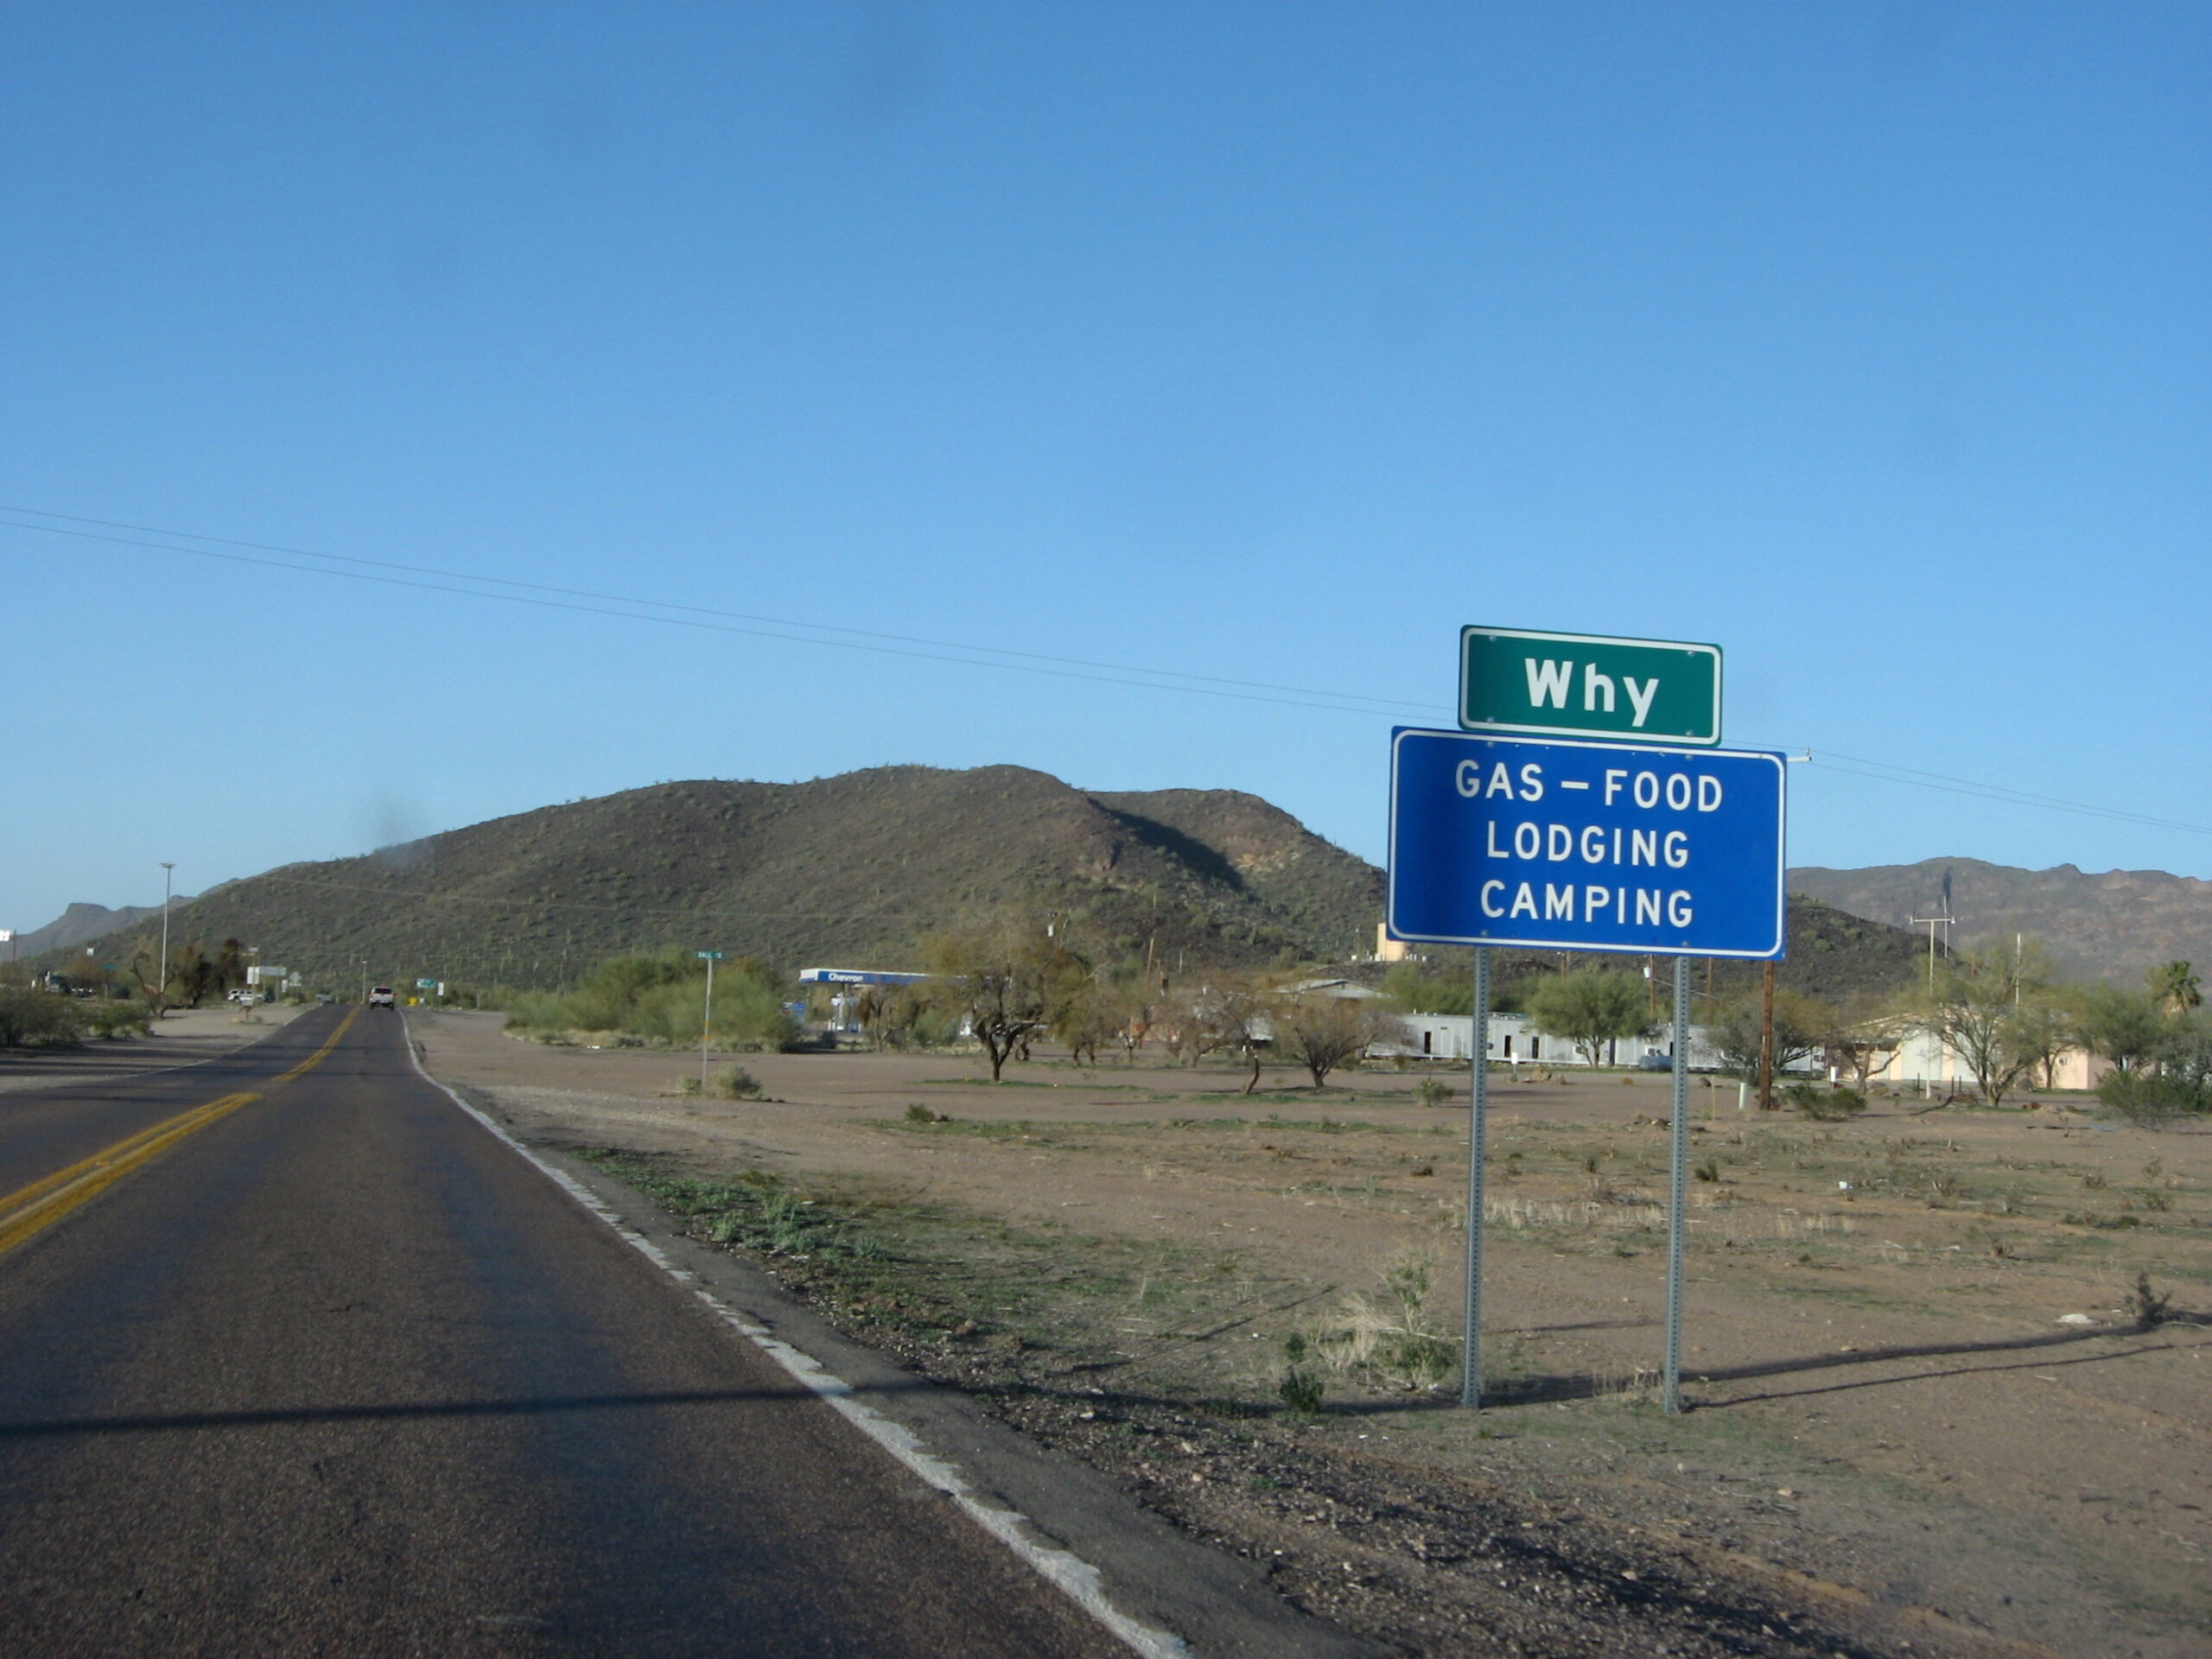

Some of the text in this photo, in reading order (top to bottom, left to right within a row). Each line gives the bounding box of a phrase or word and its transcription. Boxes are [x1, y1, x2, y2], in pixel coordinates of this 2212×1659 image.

[1524, 658, 1659, 728] Why
[1455, 760, 1545, 802] GAS
[1604, 769, 1723, 812] FOOD
[1486, 820, 1689, 869] LODGING
[1480, 879, 1694, 928] CAMPING
[828, 973, 864, 982] Chevron
